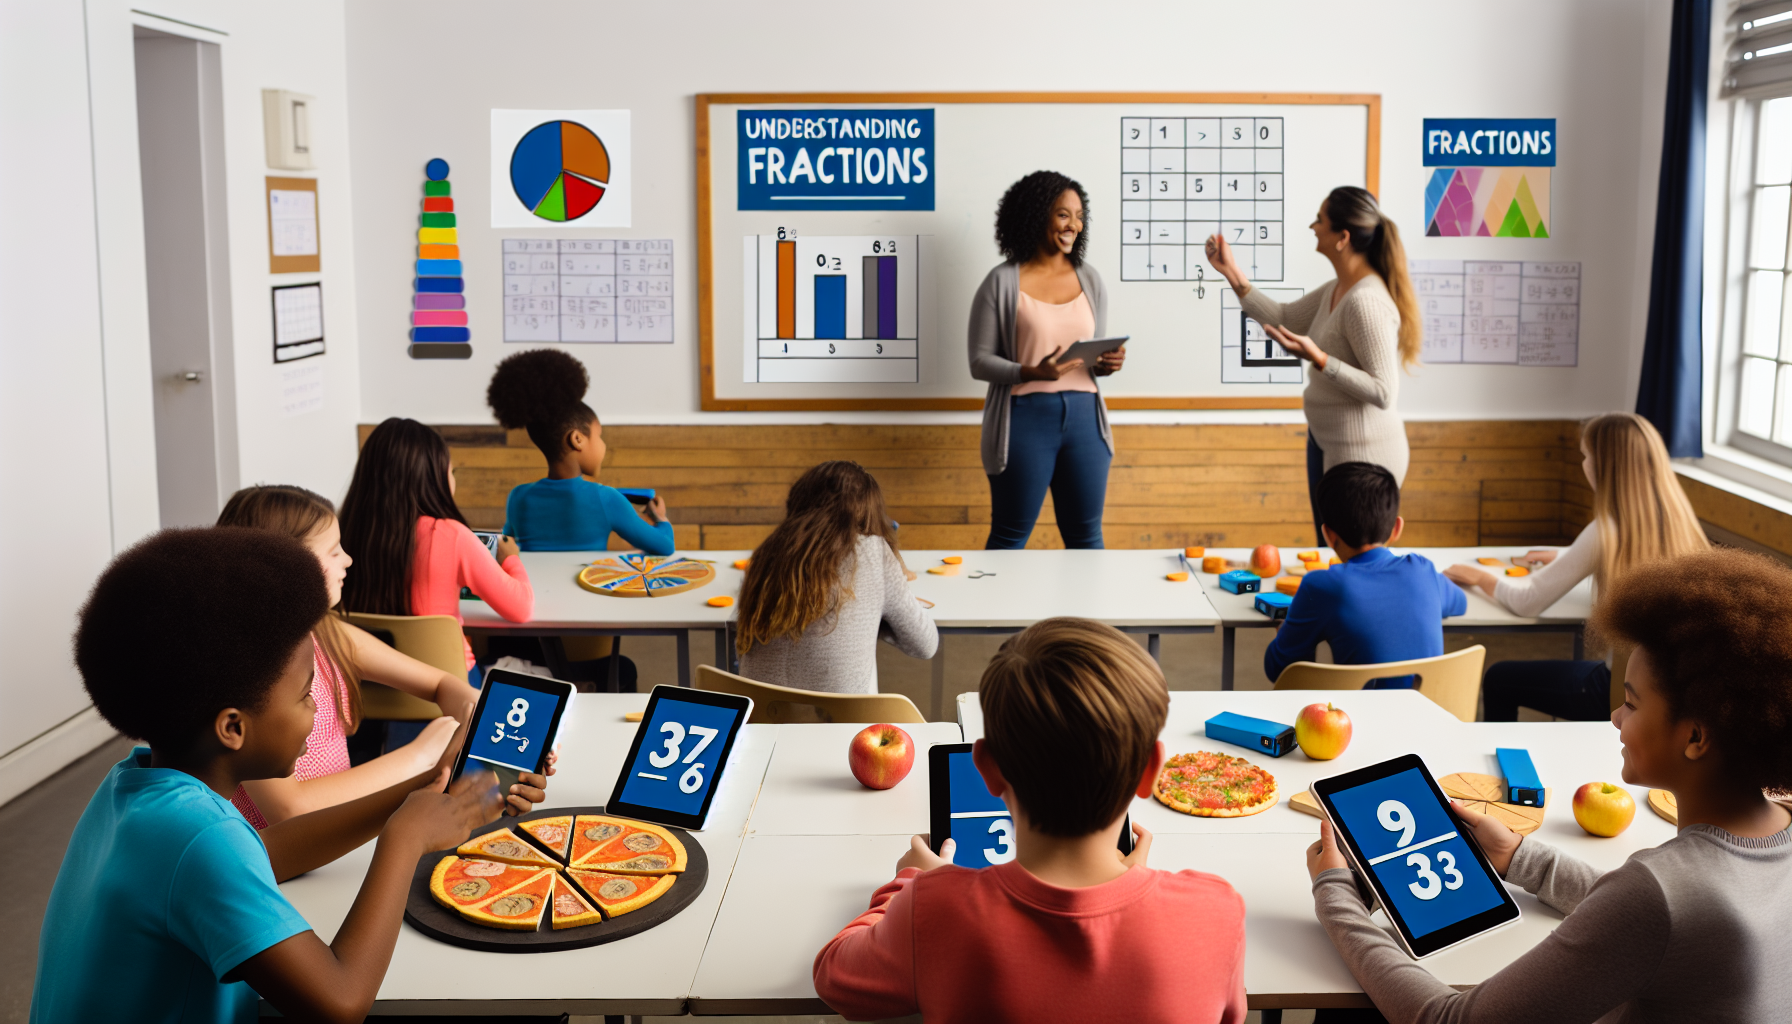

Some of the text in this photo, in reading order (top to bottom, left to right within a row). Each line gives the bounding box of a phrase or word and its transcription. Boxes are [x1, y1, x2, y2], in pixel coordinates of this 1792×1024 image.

[745, 118, 921, 140] UNDERSTANDING
[1259, 126, 1269, 140] 0
[1428, 130, 1552, 155] FRACTIONS
[748, 147, 929, 185] FRACTIONS
[506, 697, 530, 728] 8
[649, 721, 719, 769] 37
[678, 762, 705, 794] 6
[1376, 799, 1417, 848] 9
[983, 818, 1017, 865] 3
[1406, 850, 1464, 901] 33
